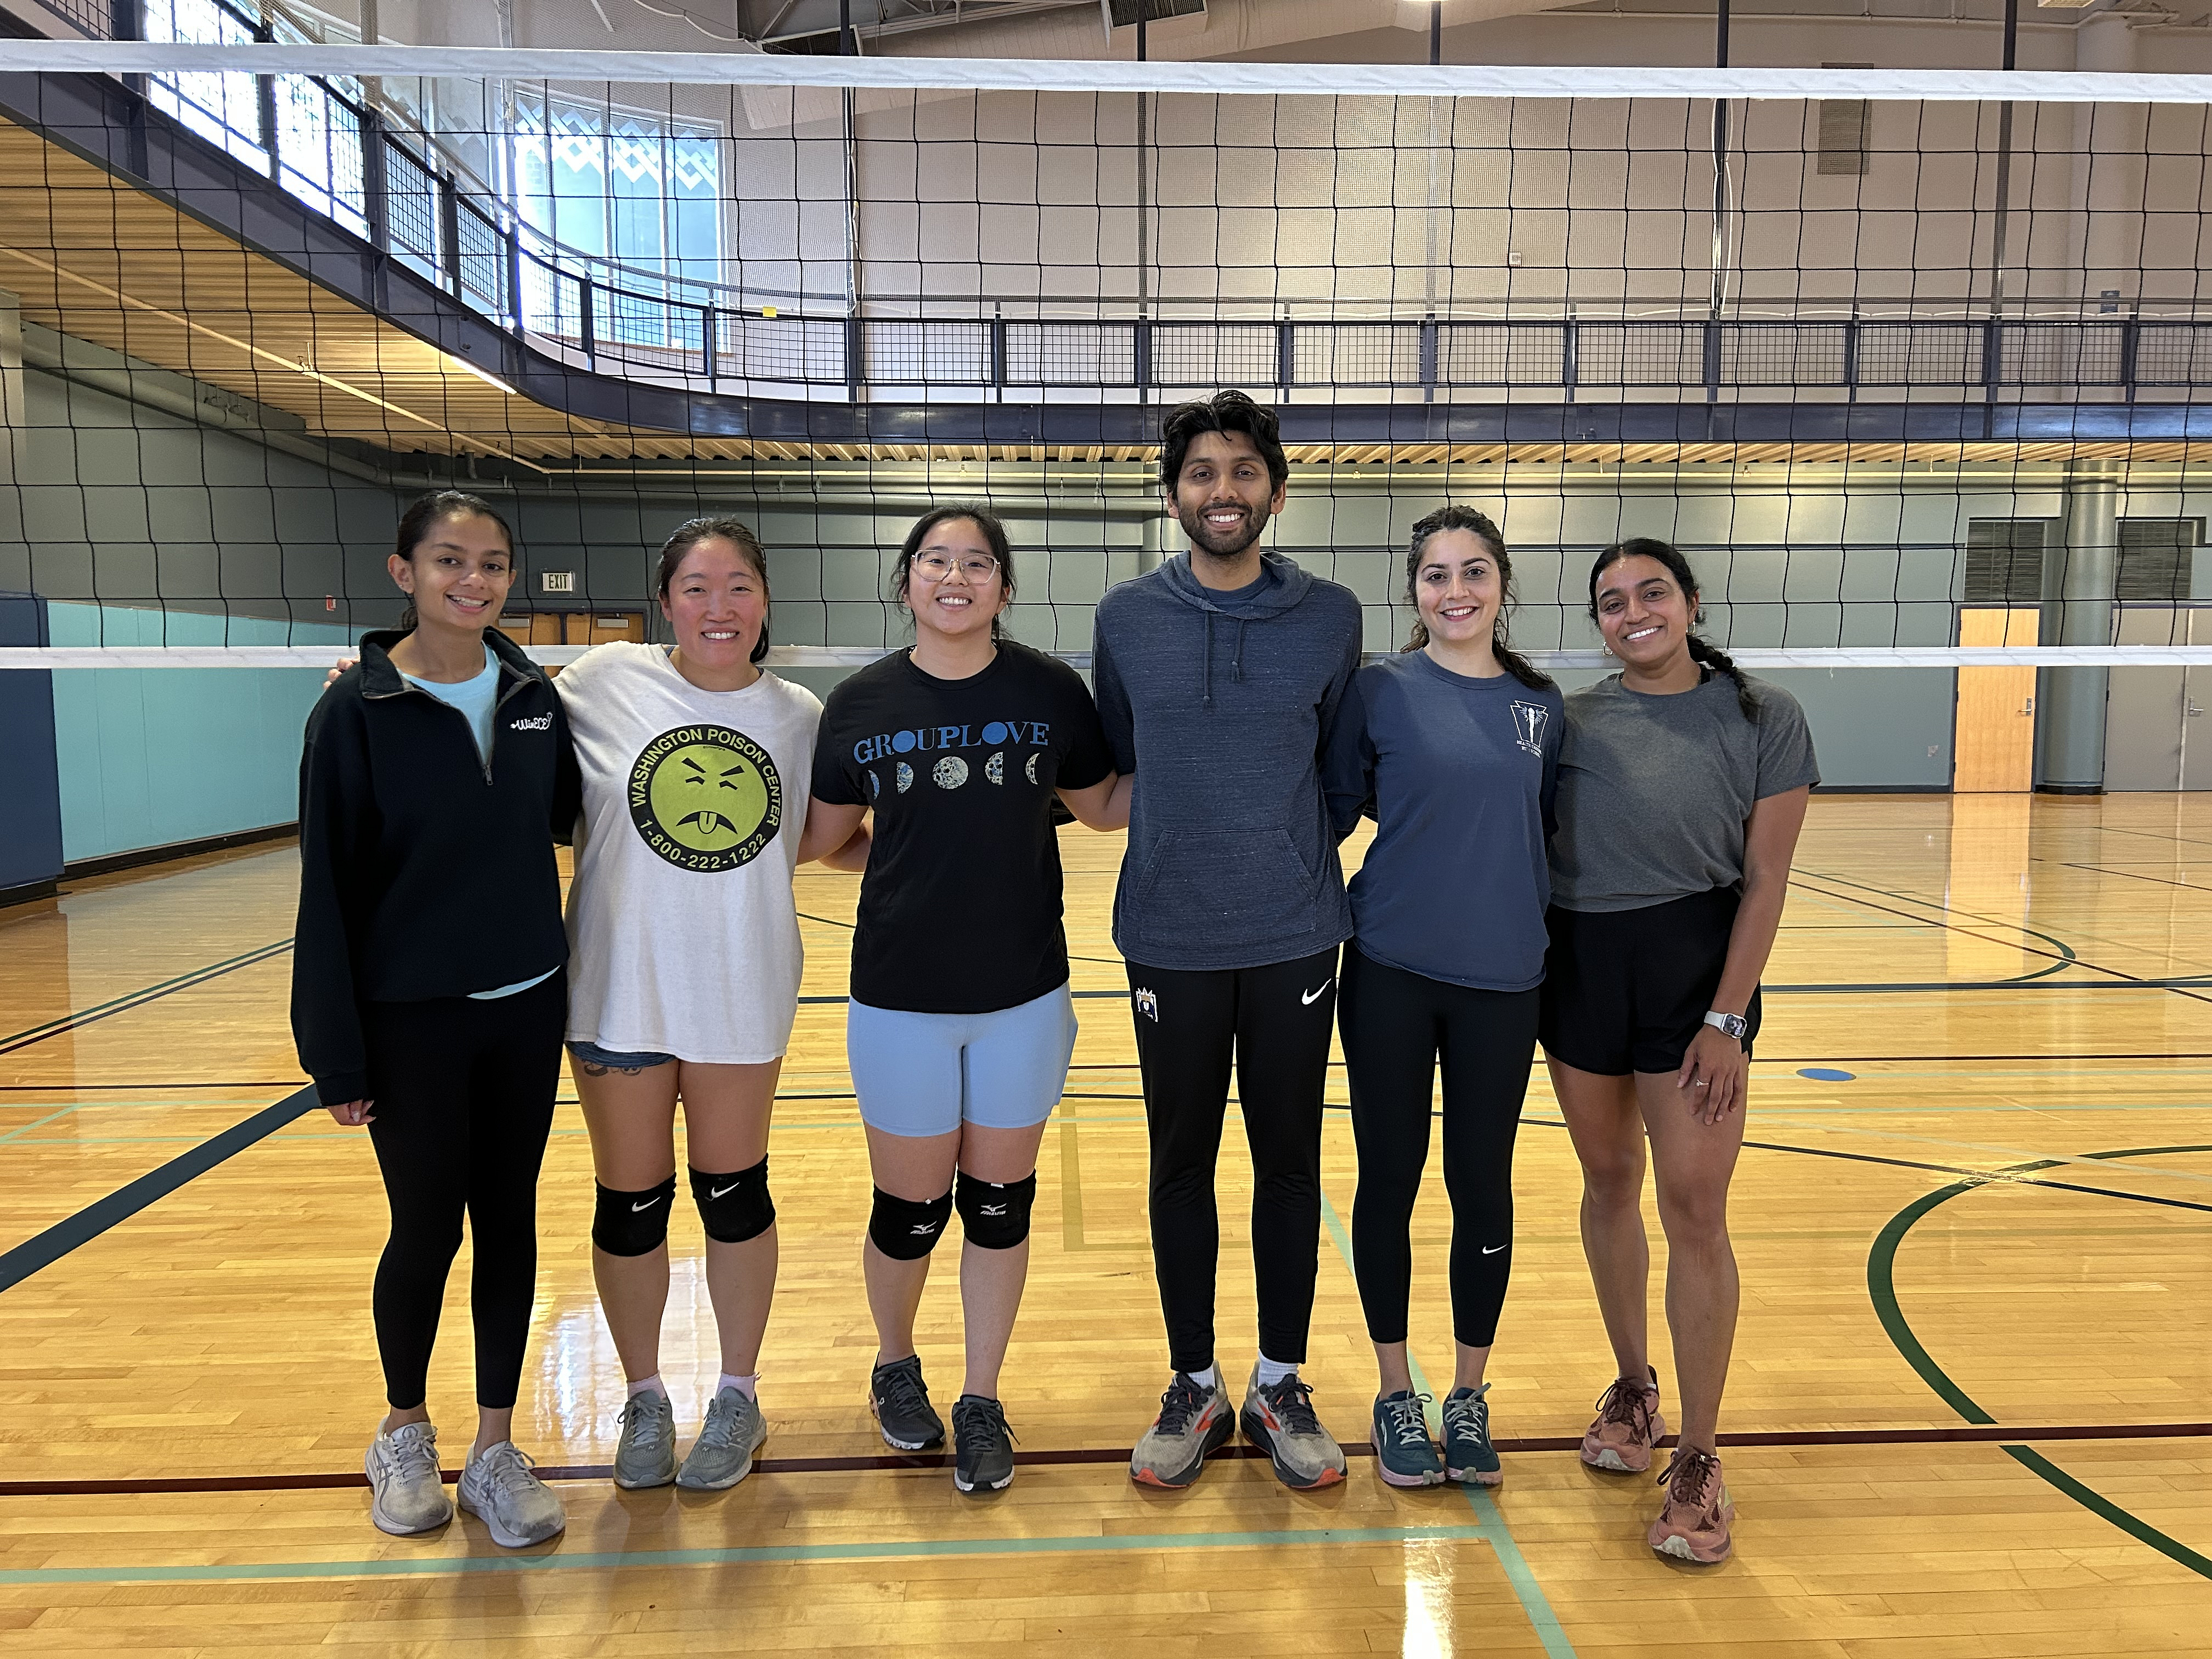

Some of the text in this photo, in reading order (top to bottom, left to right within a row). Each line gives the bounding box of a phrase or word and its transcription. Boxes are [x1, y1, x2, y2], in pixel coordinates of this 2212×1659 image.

[549, 574, 568, 589] EXIT
[853, 721, 1049, 764] GROUPLOVE
[631, 728, 781, 826] WASHINGTON POISON CENTER
[640, 819, 766, 869] 1-800-222-1222
